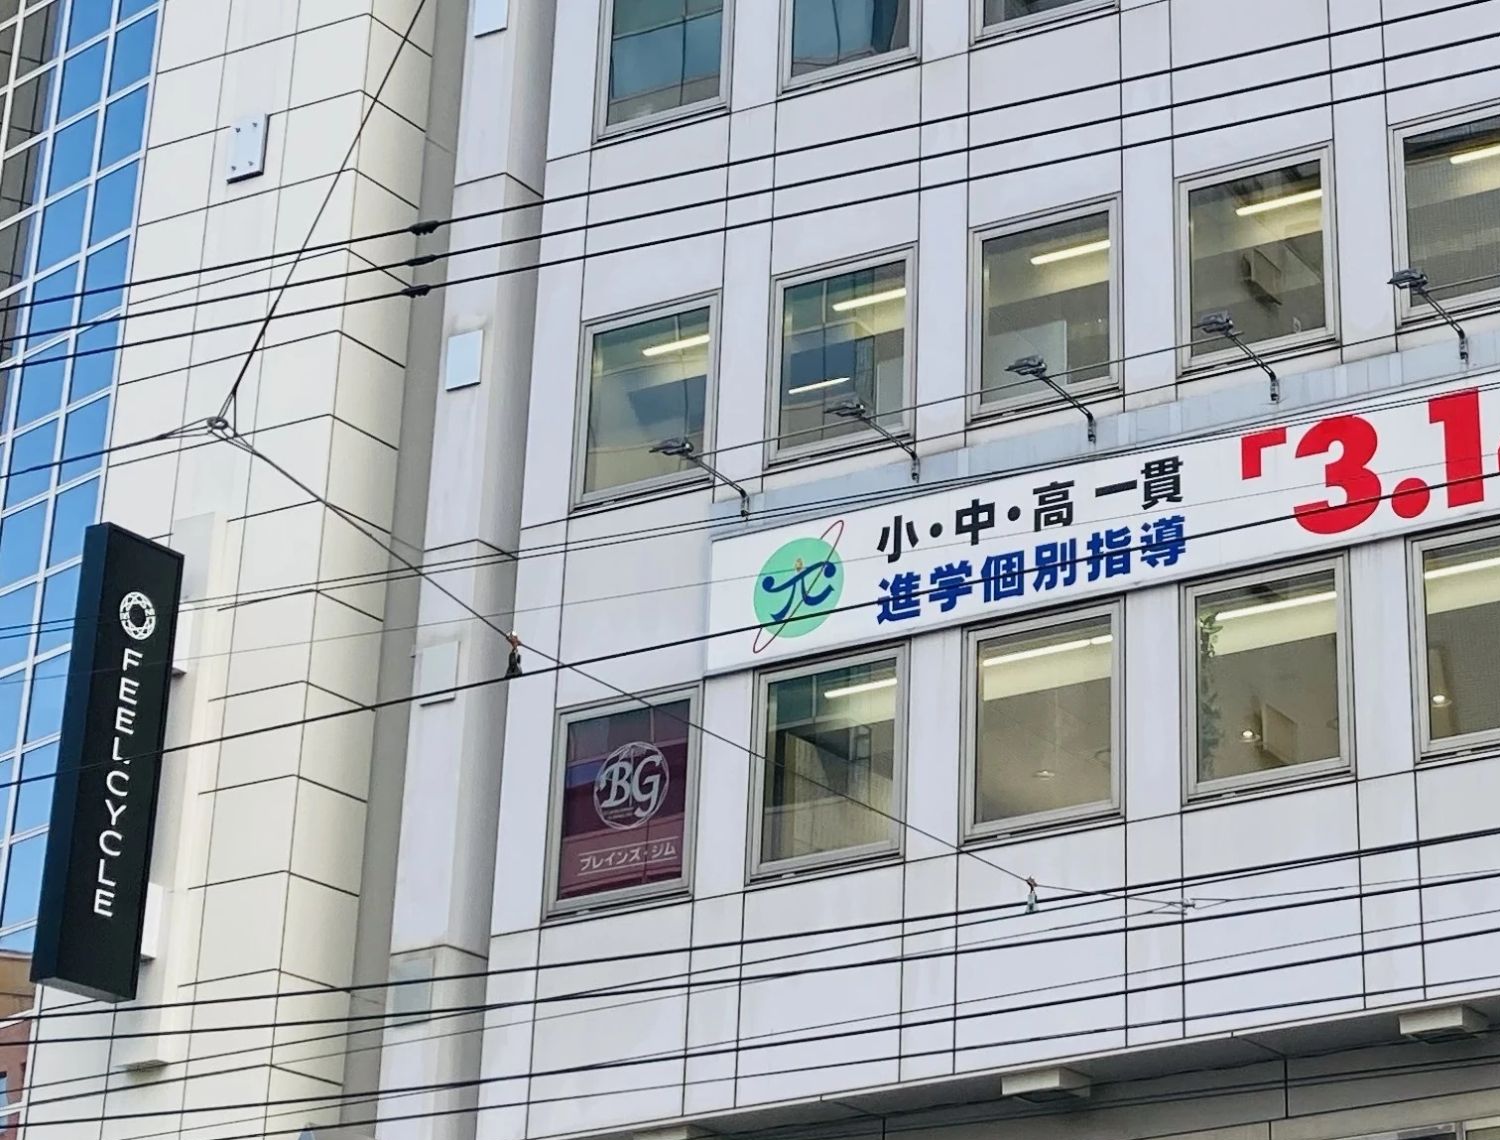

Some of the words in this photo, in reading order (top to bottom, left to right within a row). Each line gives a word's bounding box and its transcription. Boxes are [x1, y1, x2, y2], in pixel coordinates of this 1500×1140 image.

[876, 514, 1188, 625] 進学個別指導
[93, 647, 144, 918] FEELCYCLE
